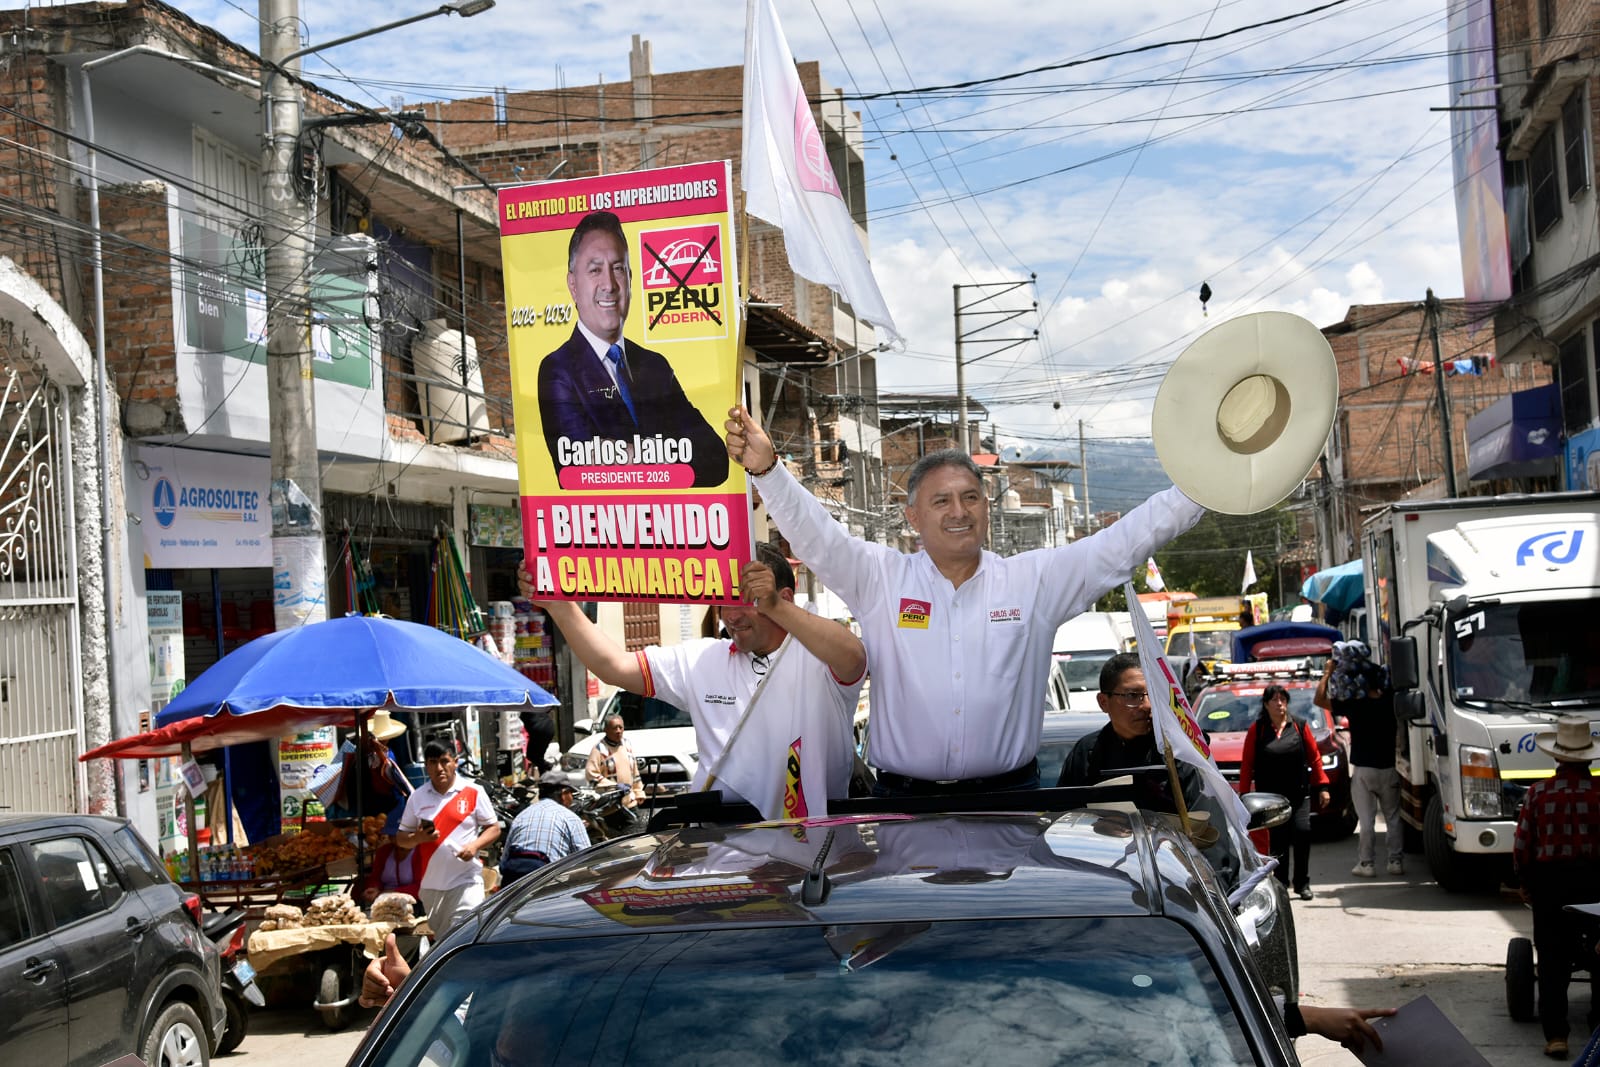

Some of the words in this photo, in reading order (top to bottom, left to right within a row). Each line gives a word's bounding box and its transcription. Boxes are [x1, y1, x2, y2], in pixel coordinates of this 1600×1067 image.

[505, 203, 517, 221] EL
[518, 197, 566, 219] PARTIDO
[568, 195, 589, 213] DEL
[590, 191, 612, 211] LOS
[613, 178, 718, 208] EMPRENDEDORES
[198, 295, 219, 318] bien
[647, 282, 720, 312] PERÚ
[557, 435, 628, 466] Carlos
[633, 434, 693, 465] Jaico
[581, 471, 644, 484] PRESIDENTE
[646, 471, 670, 483] 2026
[179, 487, 259, 511] AGROSOLTEC
[536, 556, 554, 593] A
